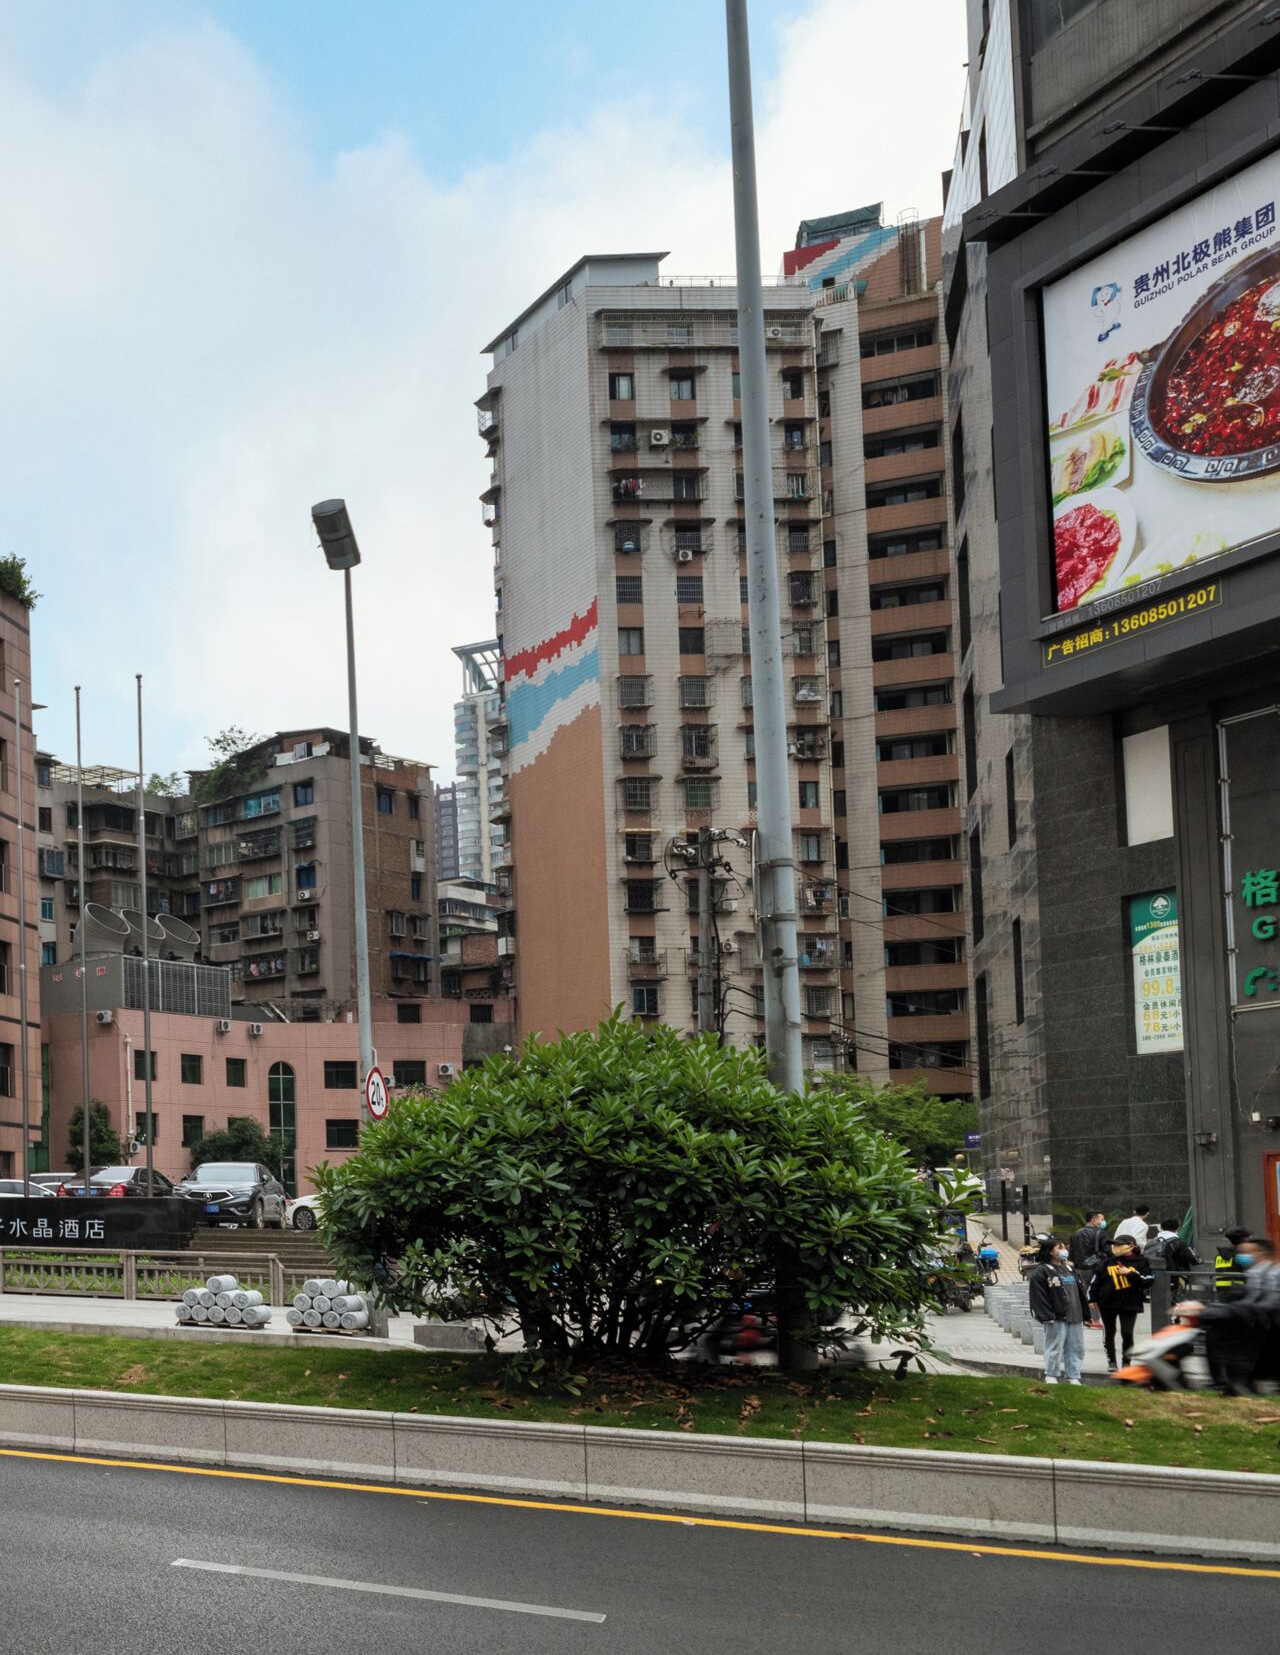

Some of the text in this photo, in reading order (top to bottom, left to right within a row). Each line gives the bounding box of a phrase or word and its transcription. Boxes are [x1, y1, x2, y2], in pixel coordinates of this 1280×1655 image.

[1133, 201, 1276, 299] 贵州北极熊集团
[1133, 226, 1276, 309] GUIZHOU POLAR BEAR GROUP
[1242, 869, 1280, 907] 格
